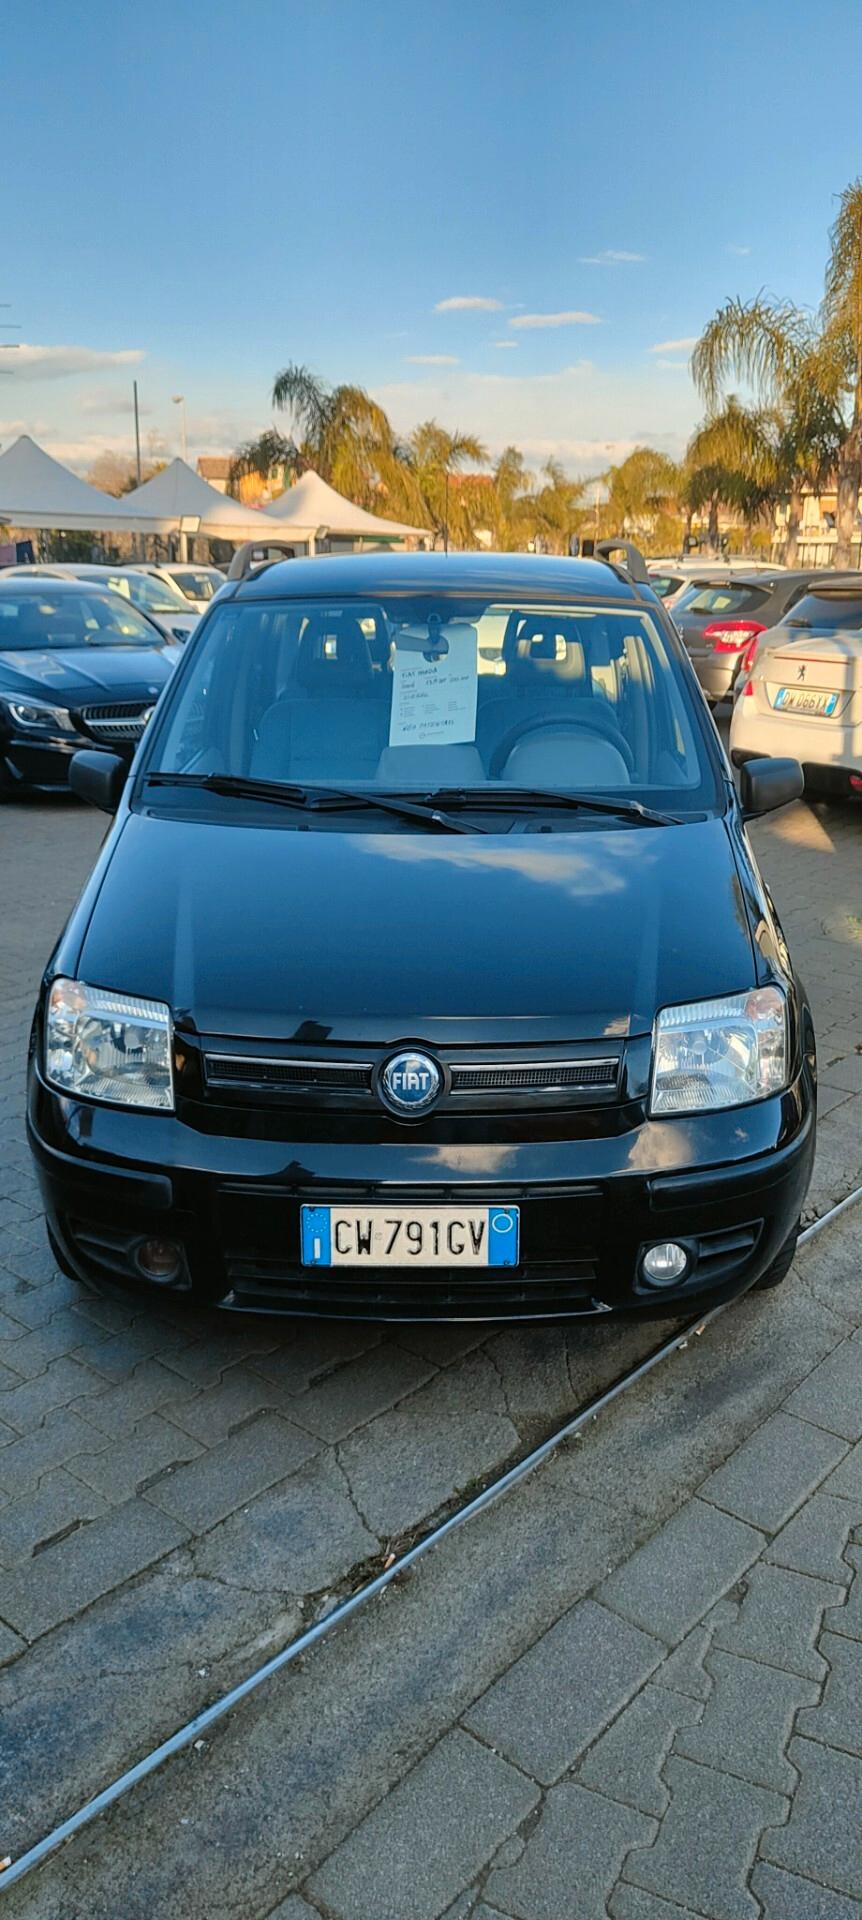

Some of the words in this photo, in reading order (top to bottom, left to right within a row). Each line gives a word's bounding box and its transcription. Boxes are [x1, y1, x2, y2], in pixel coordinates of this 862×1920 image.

[392, 1072, 429, 1090] FIAT
[335, 1220, 373, 1255] CW
[385, 1220, 485, 1255] 791GV
